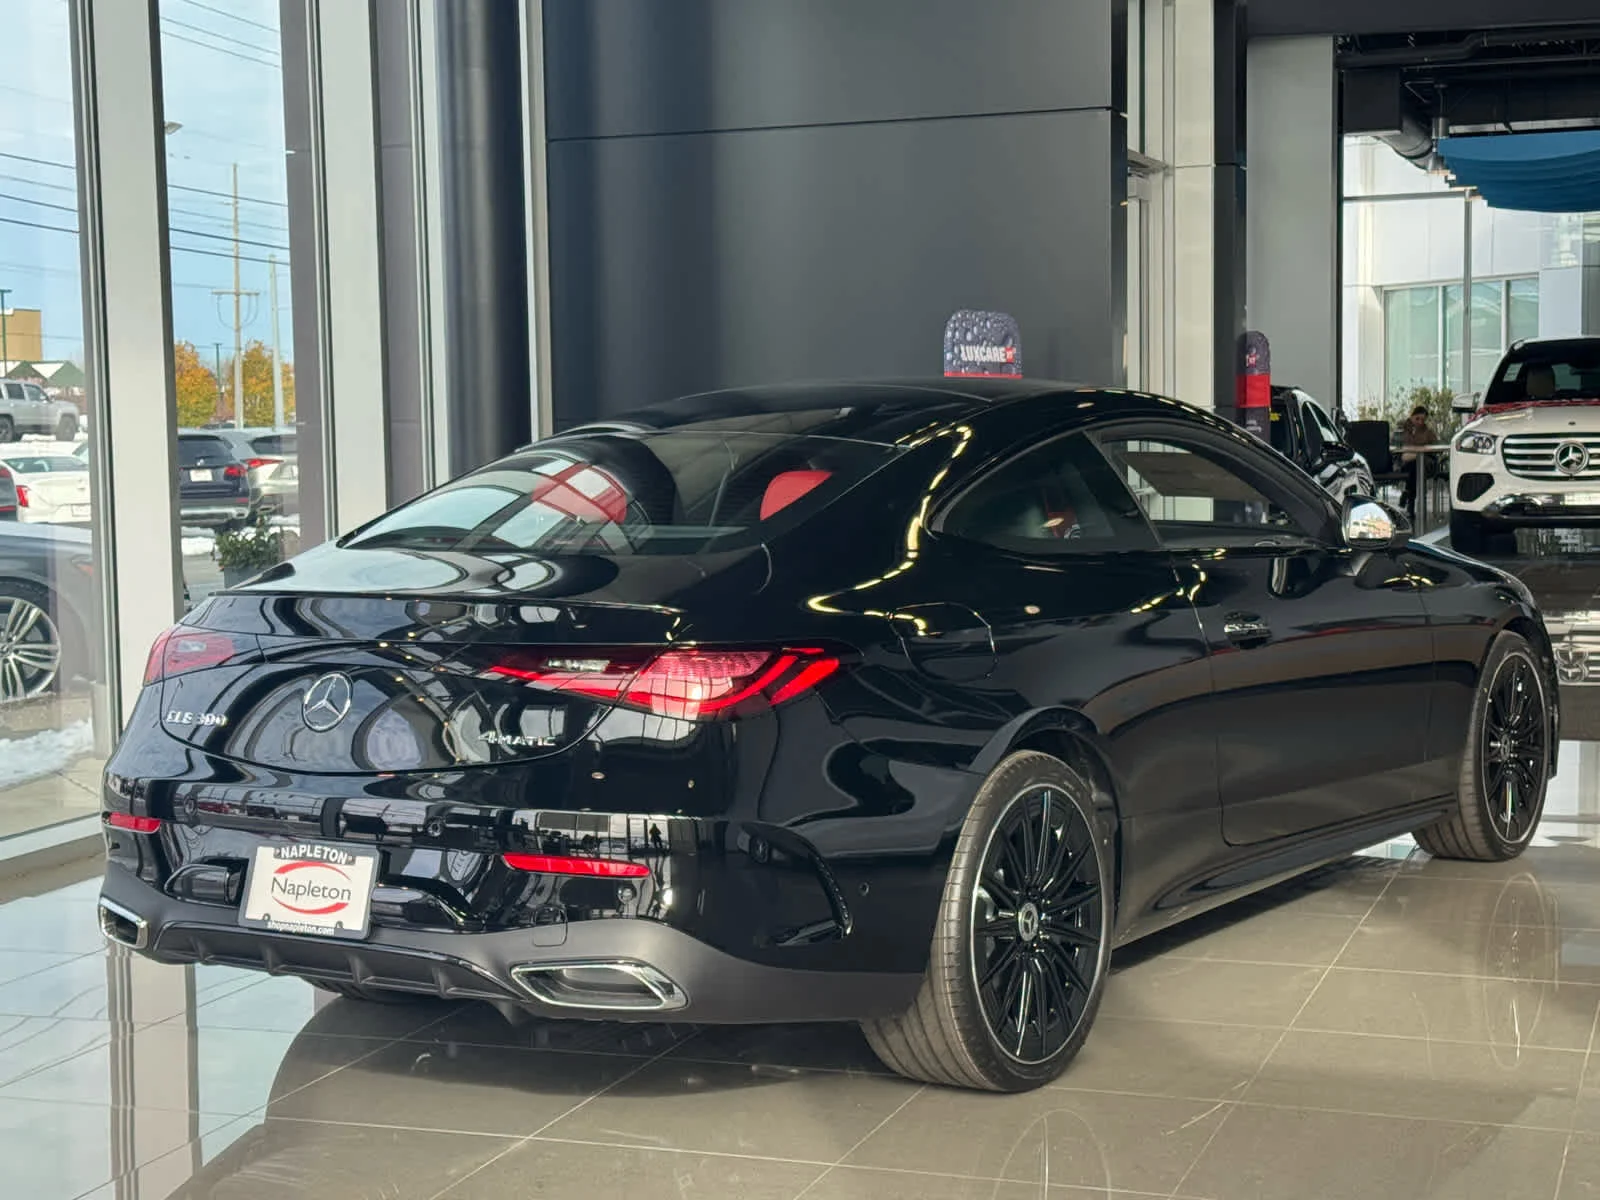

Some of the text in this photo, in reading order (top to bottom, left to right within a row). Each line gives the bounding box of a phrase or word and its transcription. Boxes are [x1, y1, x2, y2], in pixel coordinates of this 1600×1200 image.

[960, 344, 1006, 362] LUXCARE
[478, 730, 556, 746] 4MATIC
[281, 844, 347, 865] NAPLETON
[271, 876, 352, 901] Napleton
